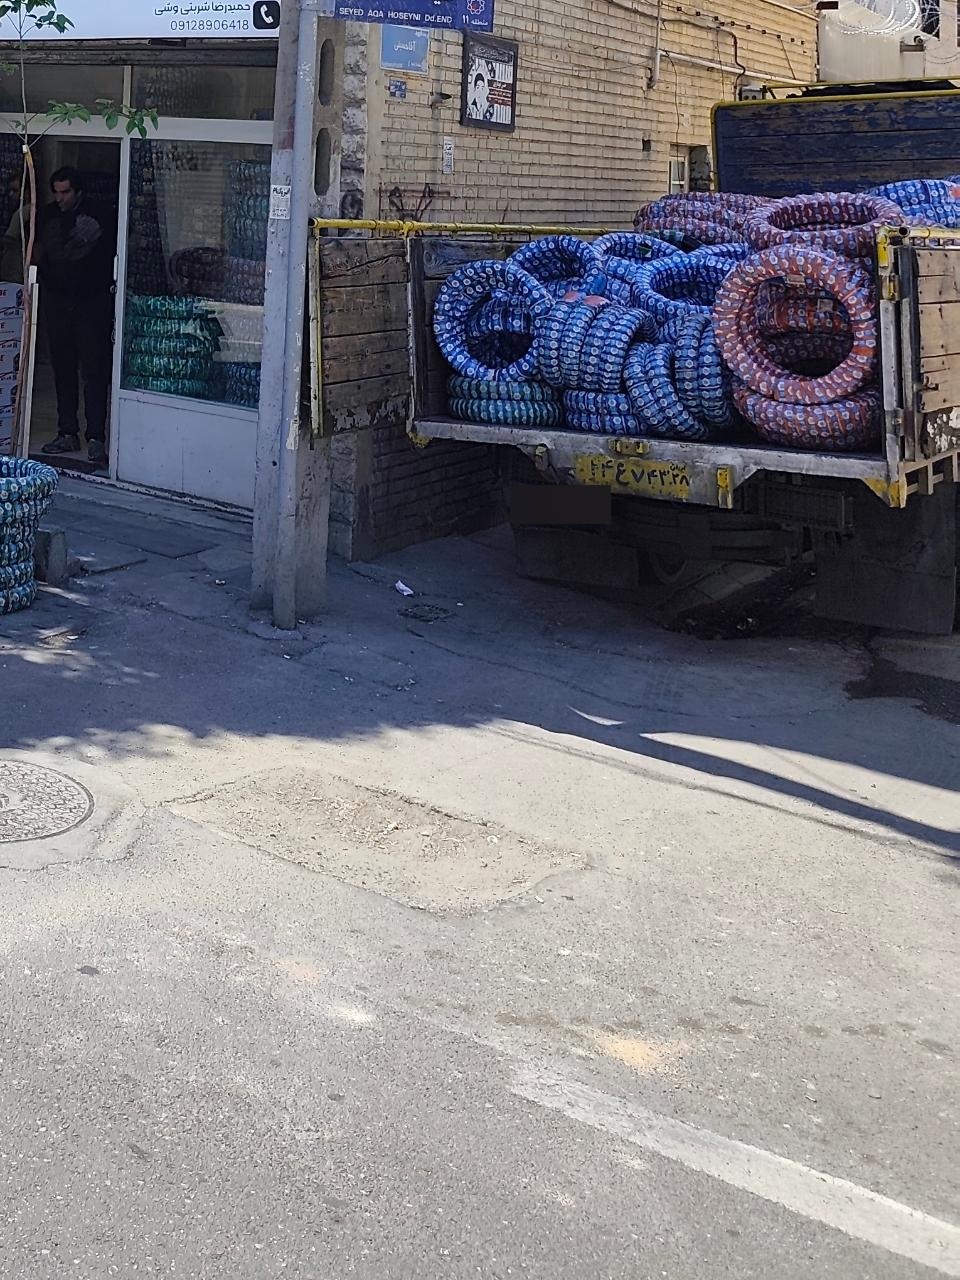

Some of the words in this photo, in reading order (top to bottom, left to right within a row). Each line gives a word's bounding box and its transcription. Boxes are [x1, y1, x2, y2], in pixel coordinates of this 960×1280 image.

[180, 2, 212, 16] شربتی
[339, 7, 364, 17] SEYED
[367, 9, 384, 18] AQA
[388, 11, 421, 21] HOSEYNI
[170, 19, 250, 31] 09128906418
